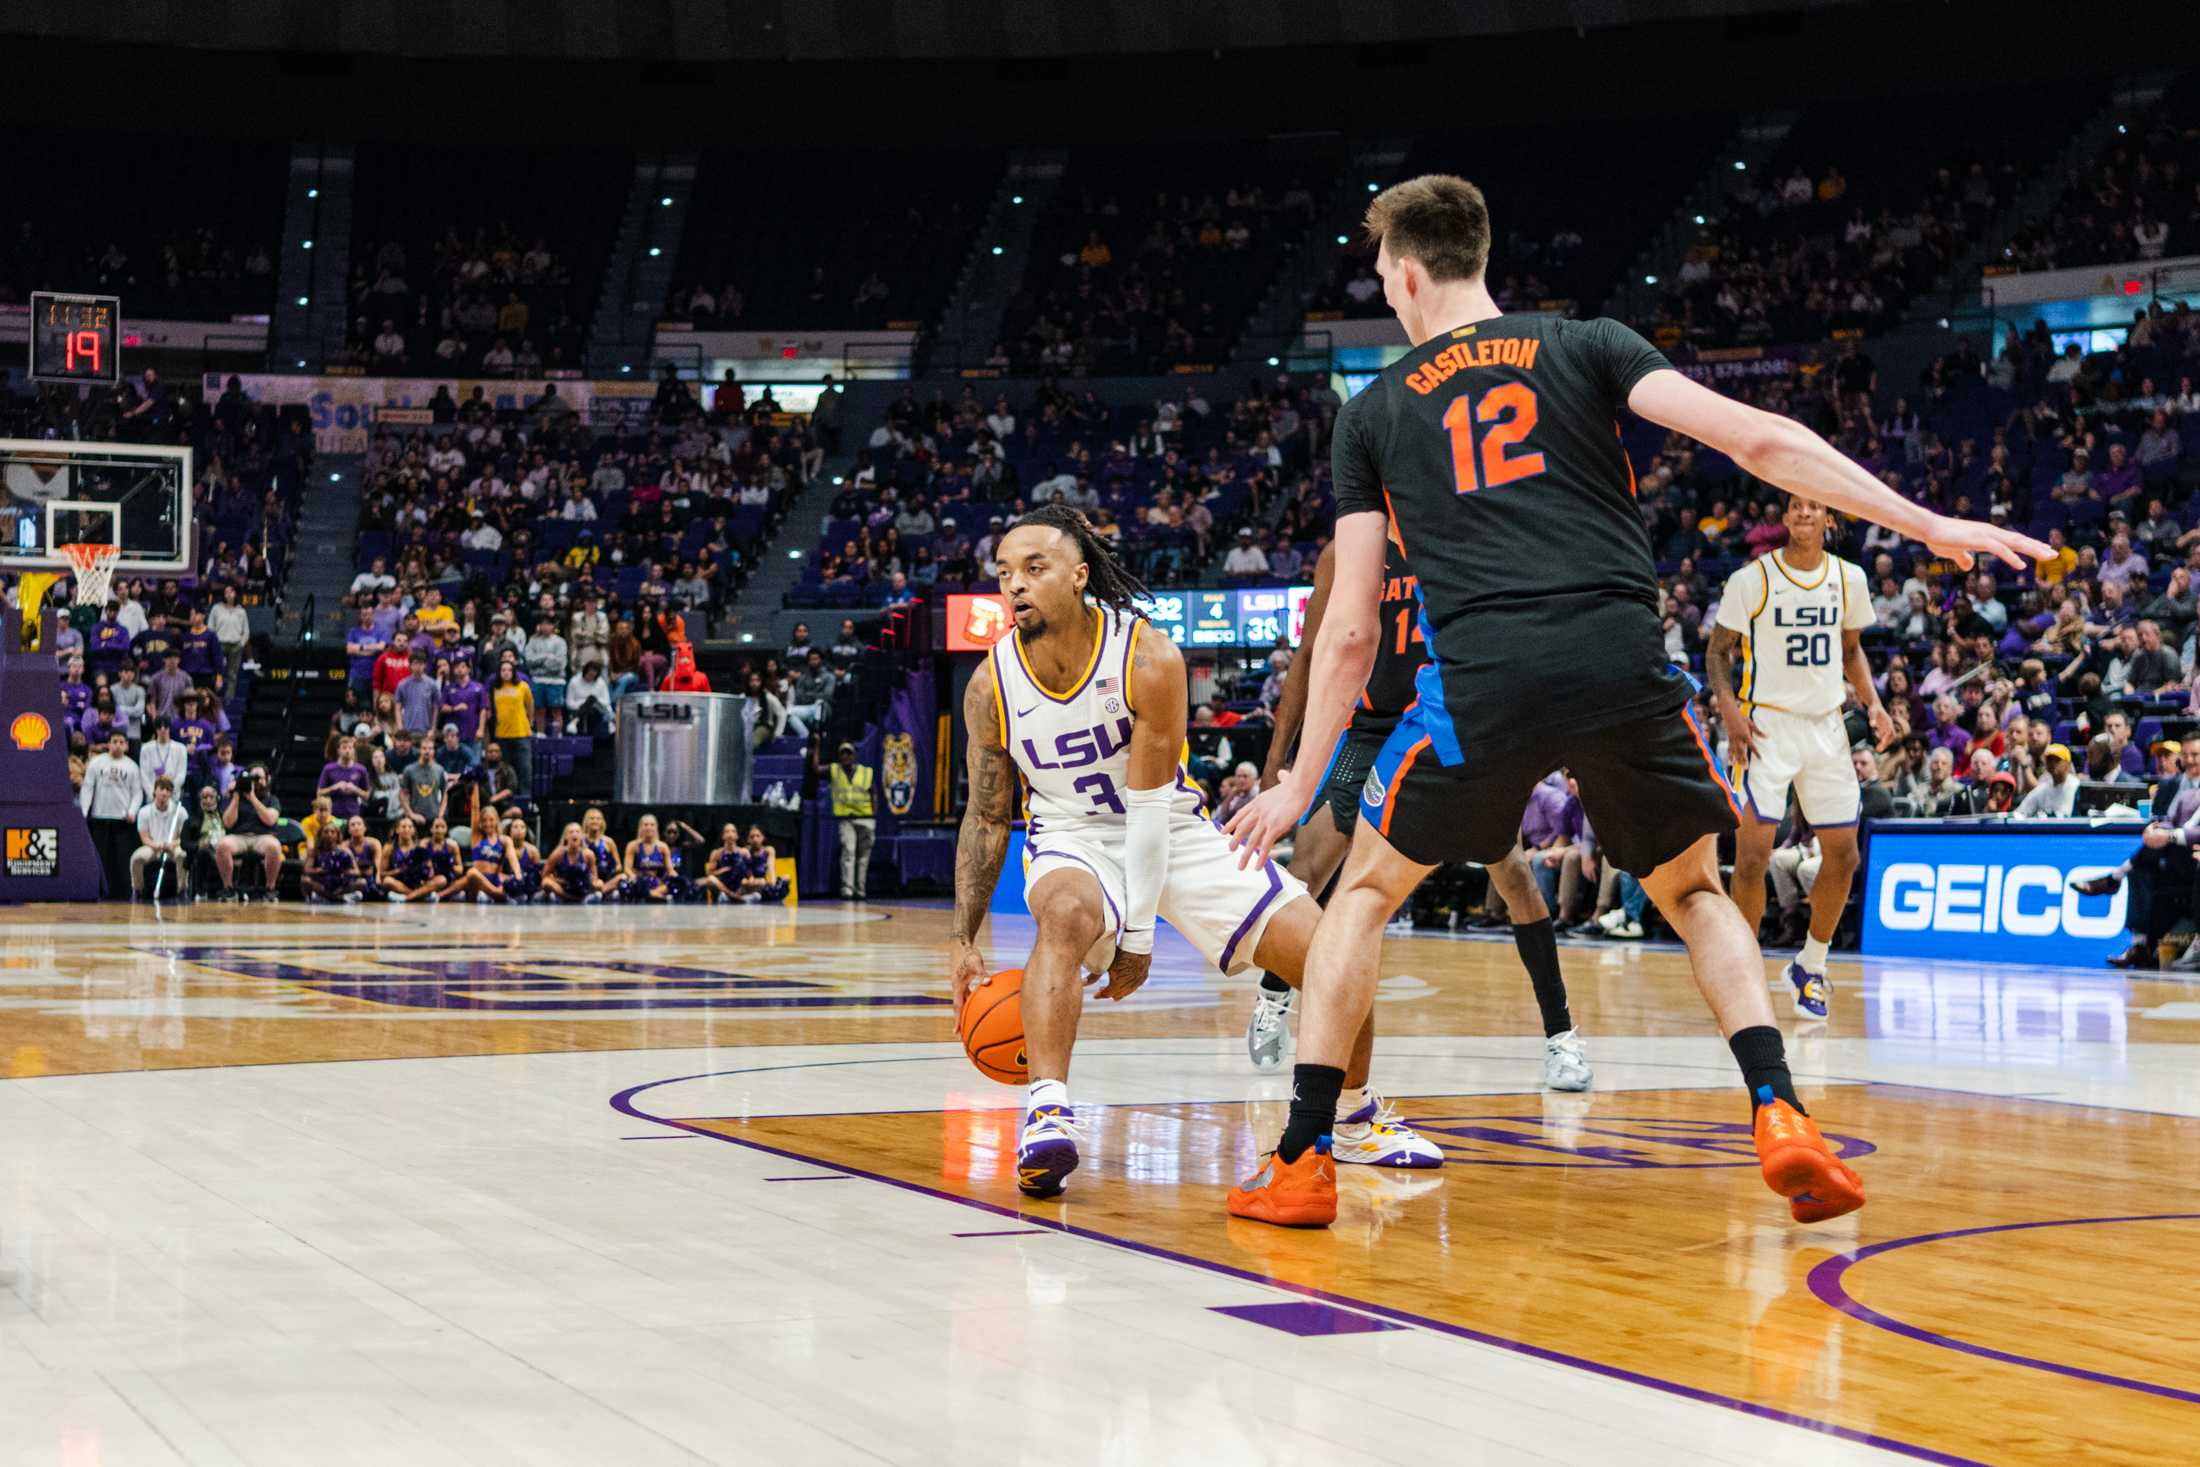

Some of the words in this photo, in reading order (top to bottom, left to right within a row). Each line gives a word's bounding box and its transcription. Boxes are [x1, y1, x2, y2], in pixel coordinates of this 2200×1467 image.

[66, 331, 100, 372] 19
[1405, 338, 1540, 395] CASTLETON
[1443, 381, 1546, 494] 12
[1208, 604, 1222, 619] 4
[1774, 607, 1838, 627] LSU
[1171, 625, 1185, 641] 2
[1785, 633, 1831, 666] 20
[638, 703, 692, 720] LSU
[1021, 717, 1133, 769] LSU
[1073, 772, 1127, 815] 3
[6, 829, 57, 860] K&E
[1878, 863, 2129, 939] GEICO
